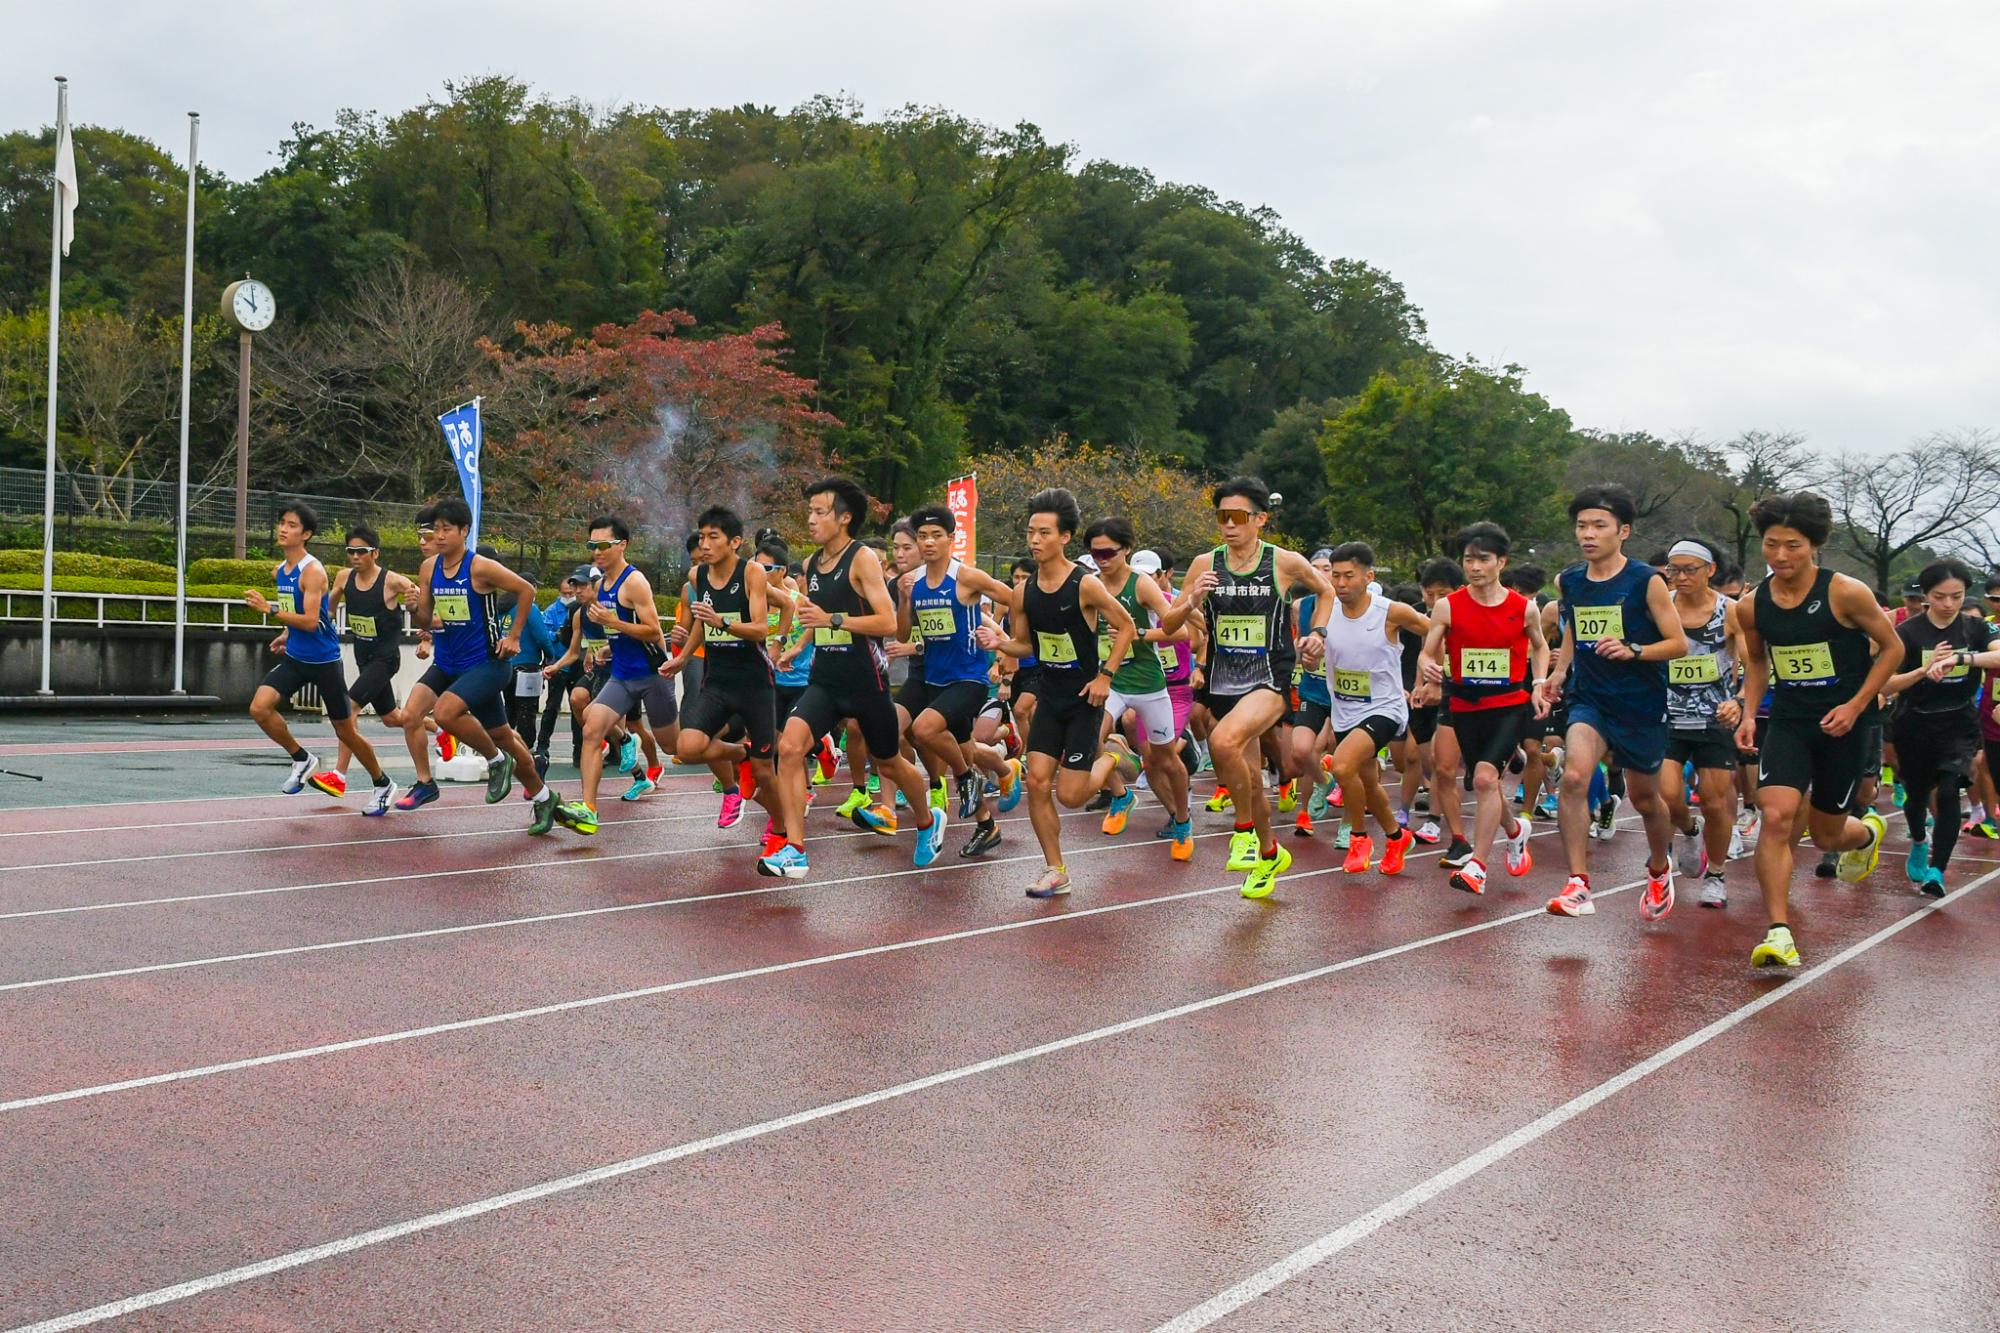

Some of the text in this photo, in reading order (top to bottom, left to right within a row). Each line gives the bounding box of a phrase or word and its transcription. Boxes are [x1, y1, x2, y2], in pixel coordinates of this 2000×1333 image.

[1214, 585, 1271, 597] 平塚市役所
[448, 605, 456, 616] 4
[922, 618, 944, 631] 206
[1579, 619, 1608, 635] 207
[1220, 627, 1249, 641] 411
[1051, 643, 1059, 657] 2
[1466, 659, 1497, 673] 414
[1788, 657, 1813, 674] 35
[1674, 666, 1703, 679] 701
[1336, 678, 1359, 691] 403
